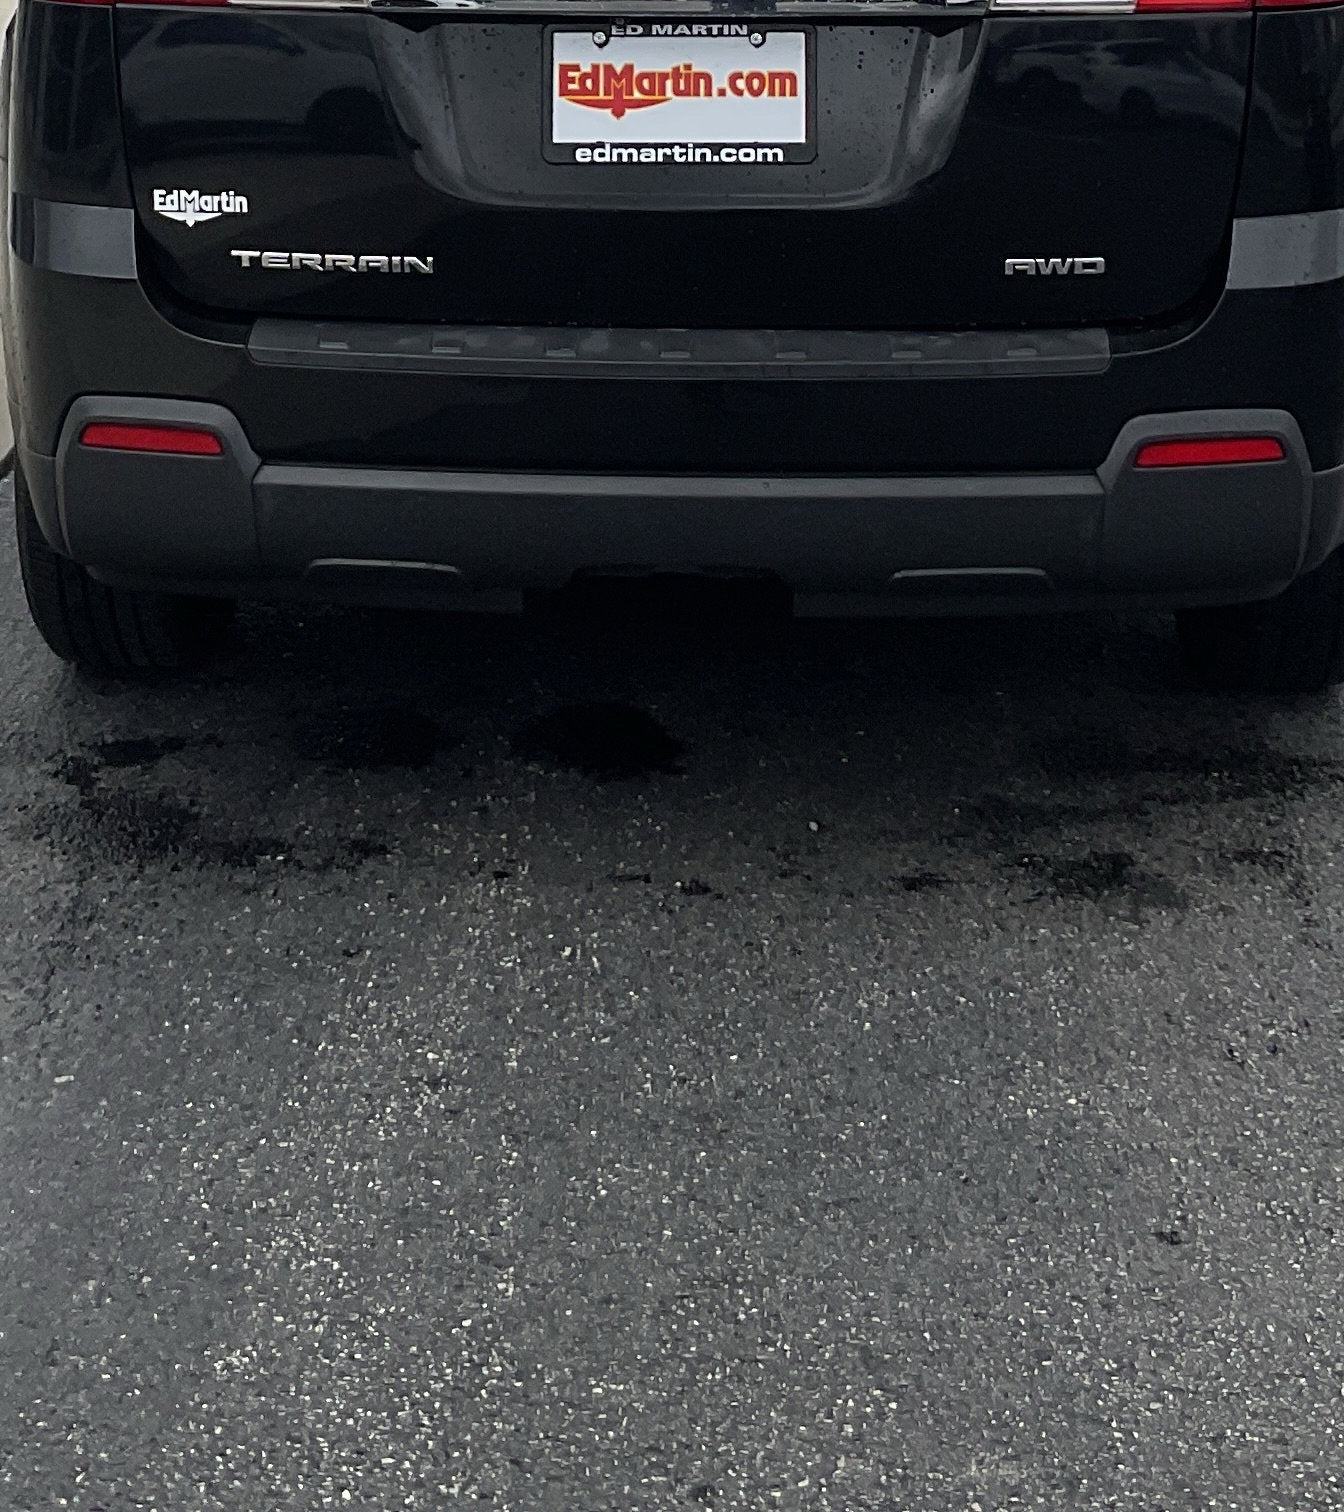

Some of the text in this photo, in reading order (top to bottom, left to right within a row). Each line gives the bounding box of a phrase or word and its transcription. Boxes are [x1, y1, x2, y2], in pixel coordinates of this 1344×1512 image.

[610, 24, 748, 36] ED MARTIN
[558, 63, 798, 103] EdMartin.com
[575, 143, 784, 163] edmartin.com
[153, 189, 248, 215] EdMartin
[230, 249, 434, 274] TERRAIN
[1004, 257, 1105, 276] AWD
